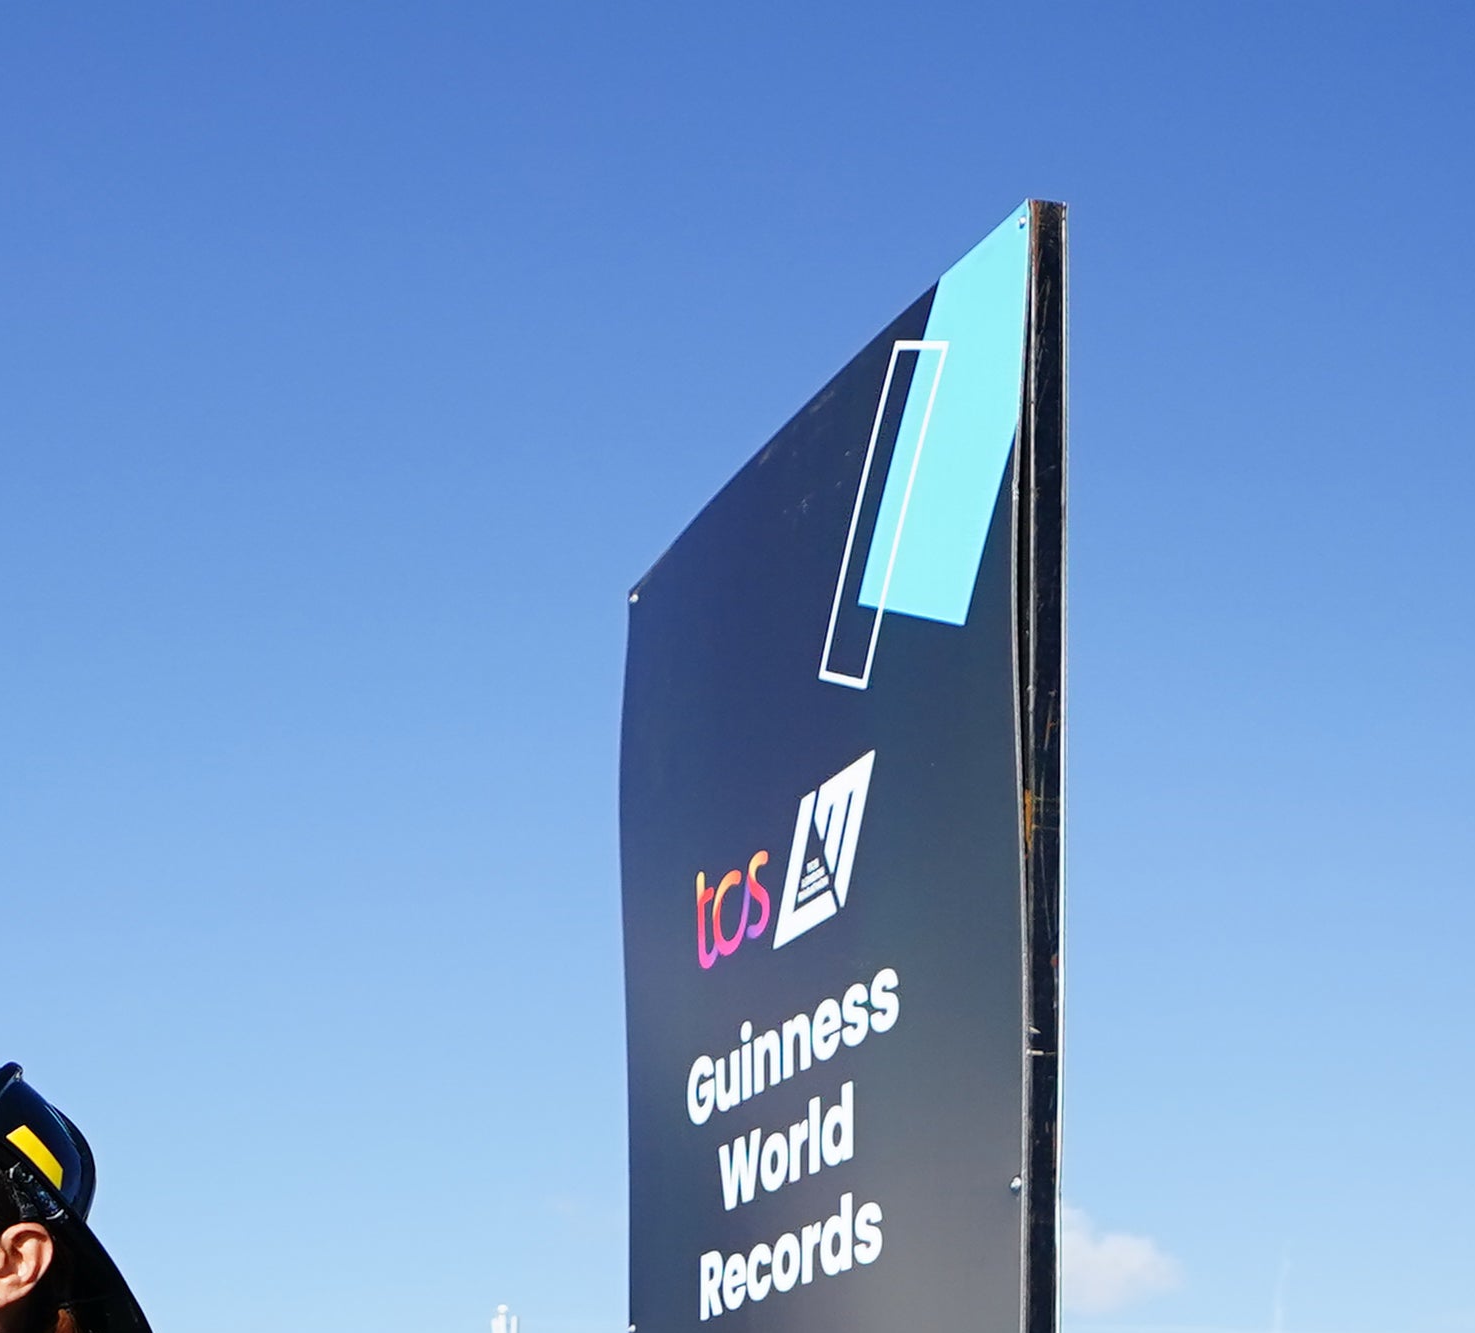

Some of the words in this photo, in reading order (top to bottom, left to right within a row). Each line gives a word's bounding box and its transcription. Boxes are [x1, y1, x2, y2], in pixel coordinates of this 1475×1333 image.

[695, 850, 771, 970] tcs
[686, 967, 900, 1126] Guinness
[718, 1080, 855, 1211] World
[699, 1191, 884, 1321] Records
